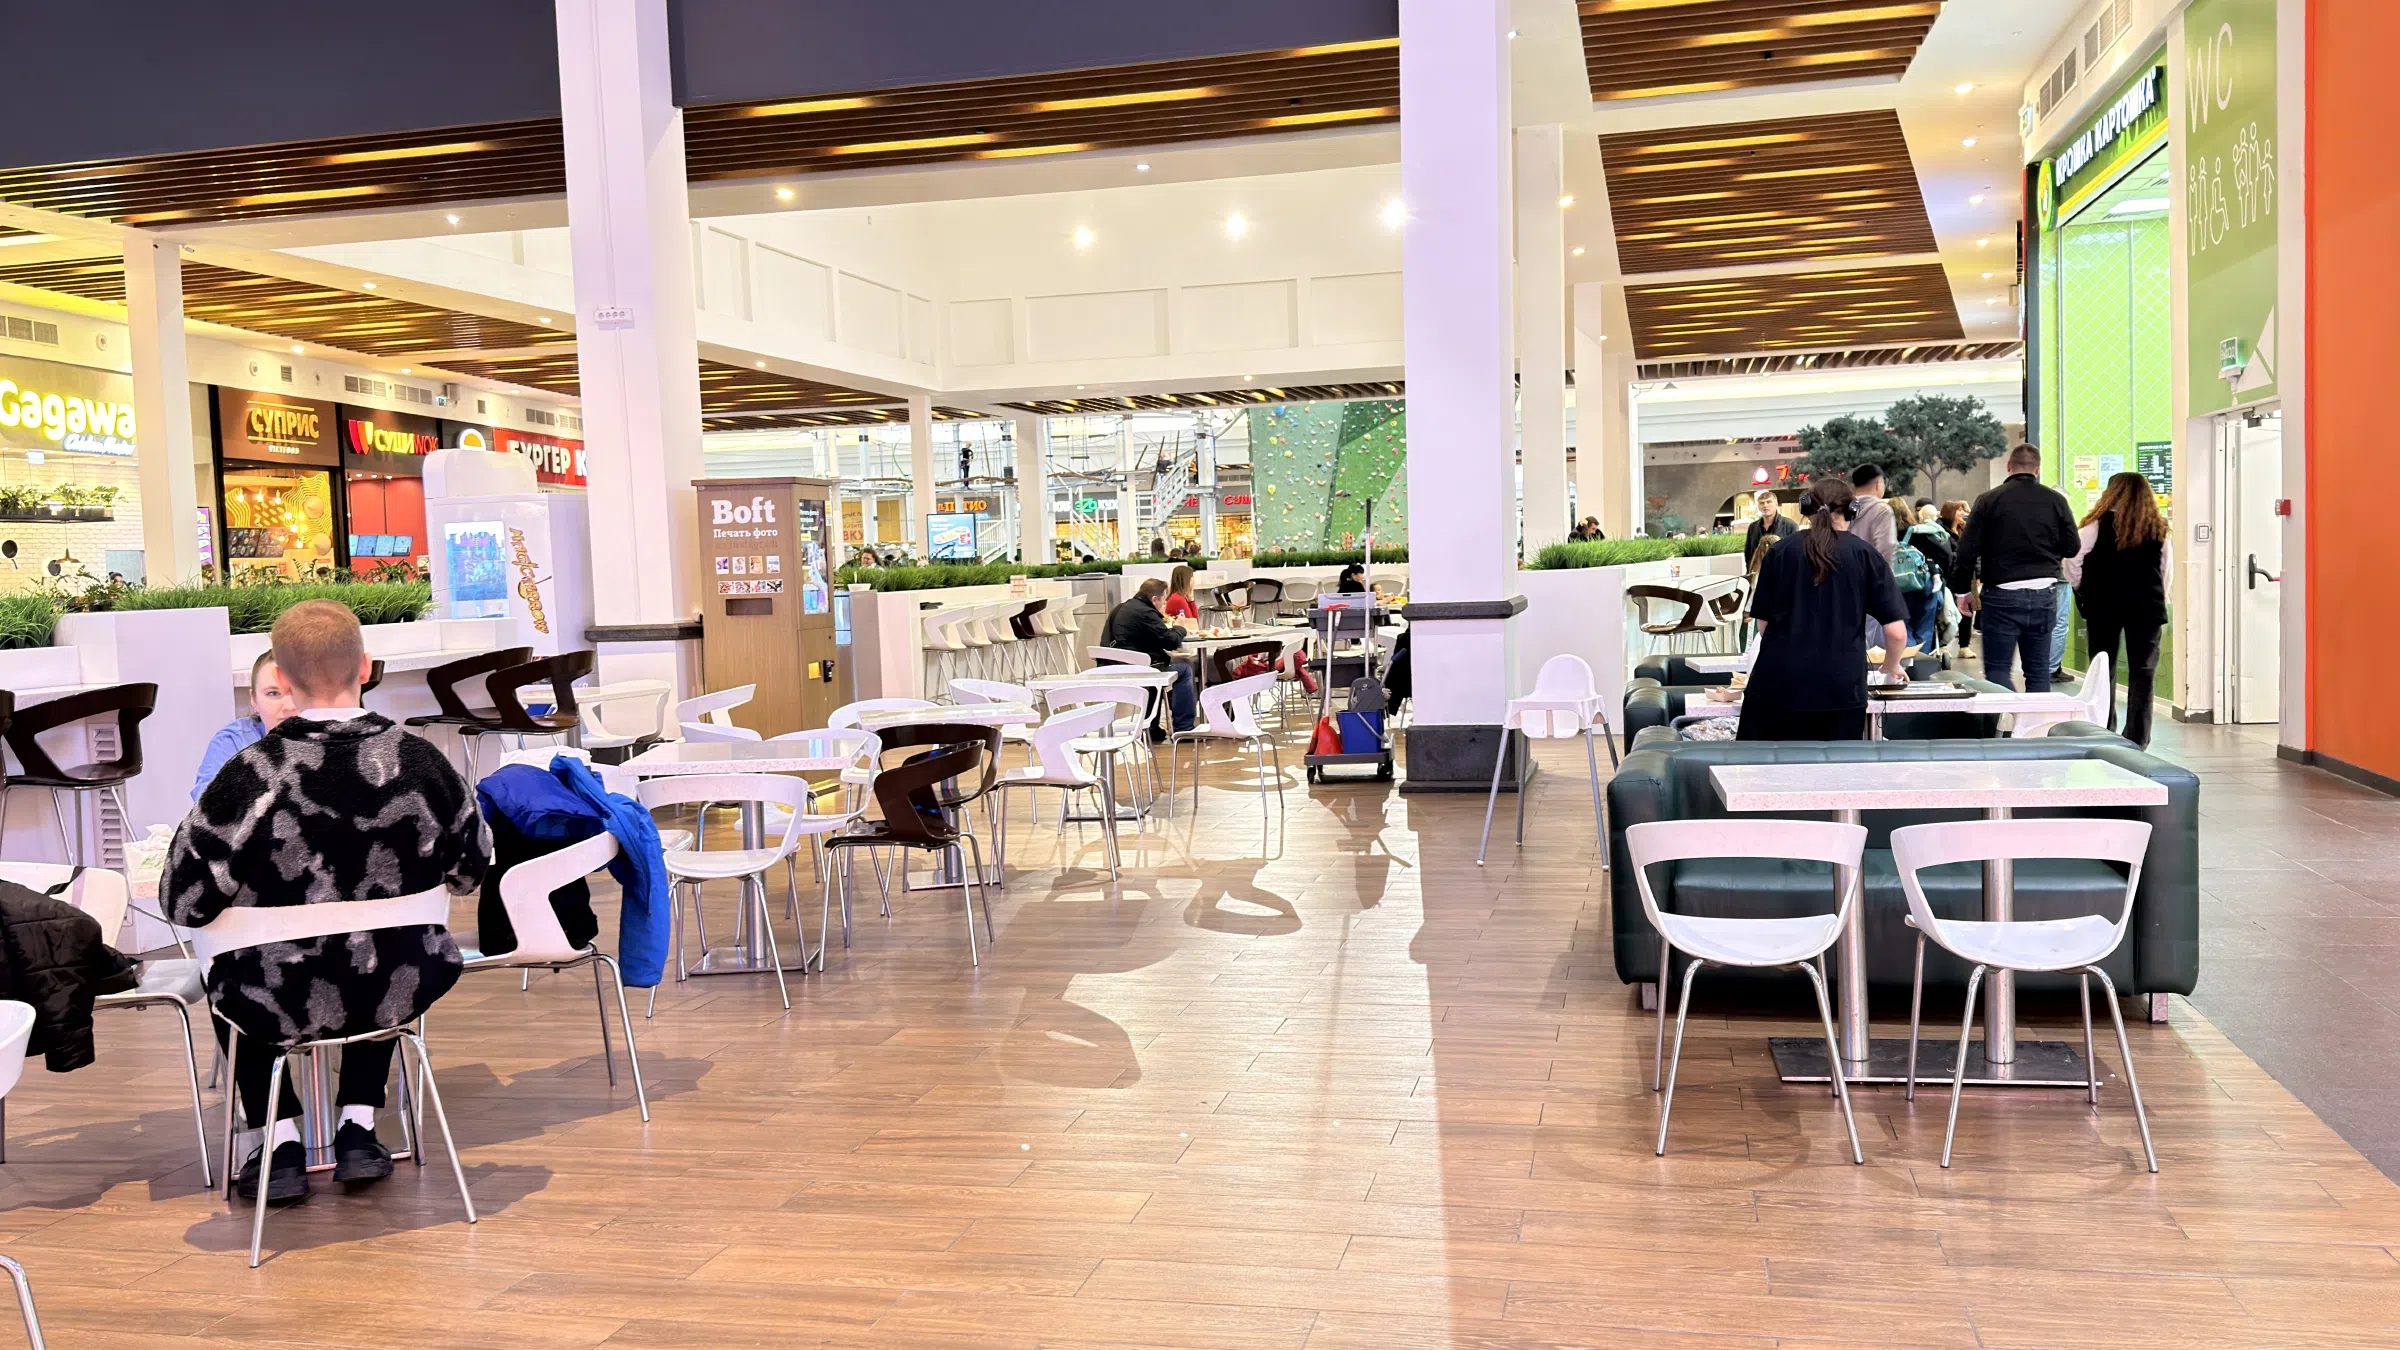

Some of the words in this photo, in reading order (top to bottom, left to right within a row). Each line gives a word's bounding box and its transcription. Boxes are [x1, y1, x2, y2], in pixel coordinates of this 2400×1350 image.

[2187, 22, 2232, 133] WC
[2056, 129, 2093, 187] КРОШКА
[2095, 70, 2155, 152] КАРТОШКА
[0, 380, 136, 441] Gagawa
[251, 407, 320, 439] СУПРИС
[711, 496, 776, 524] Boft
[944, 500, 988, 512] ПТИО
[713, 529, 752, 538] Печать
[753, 527, 779, 539] фото
